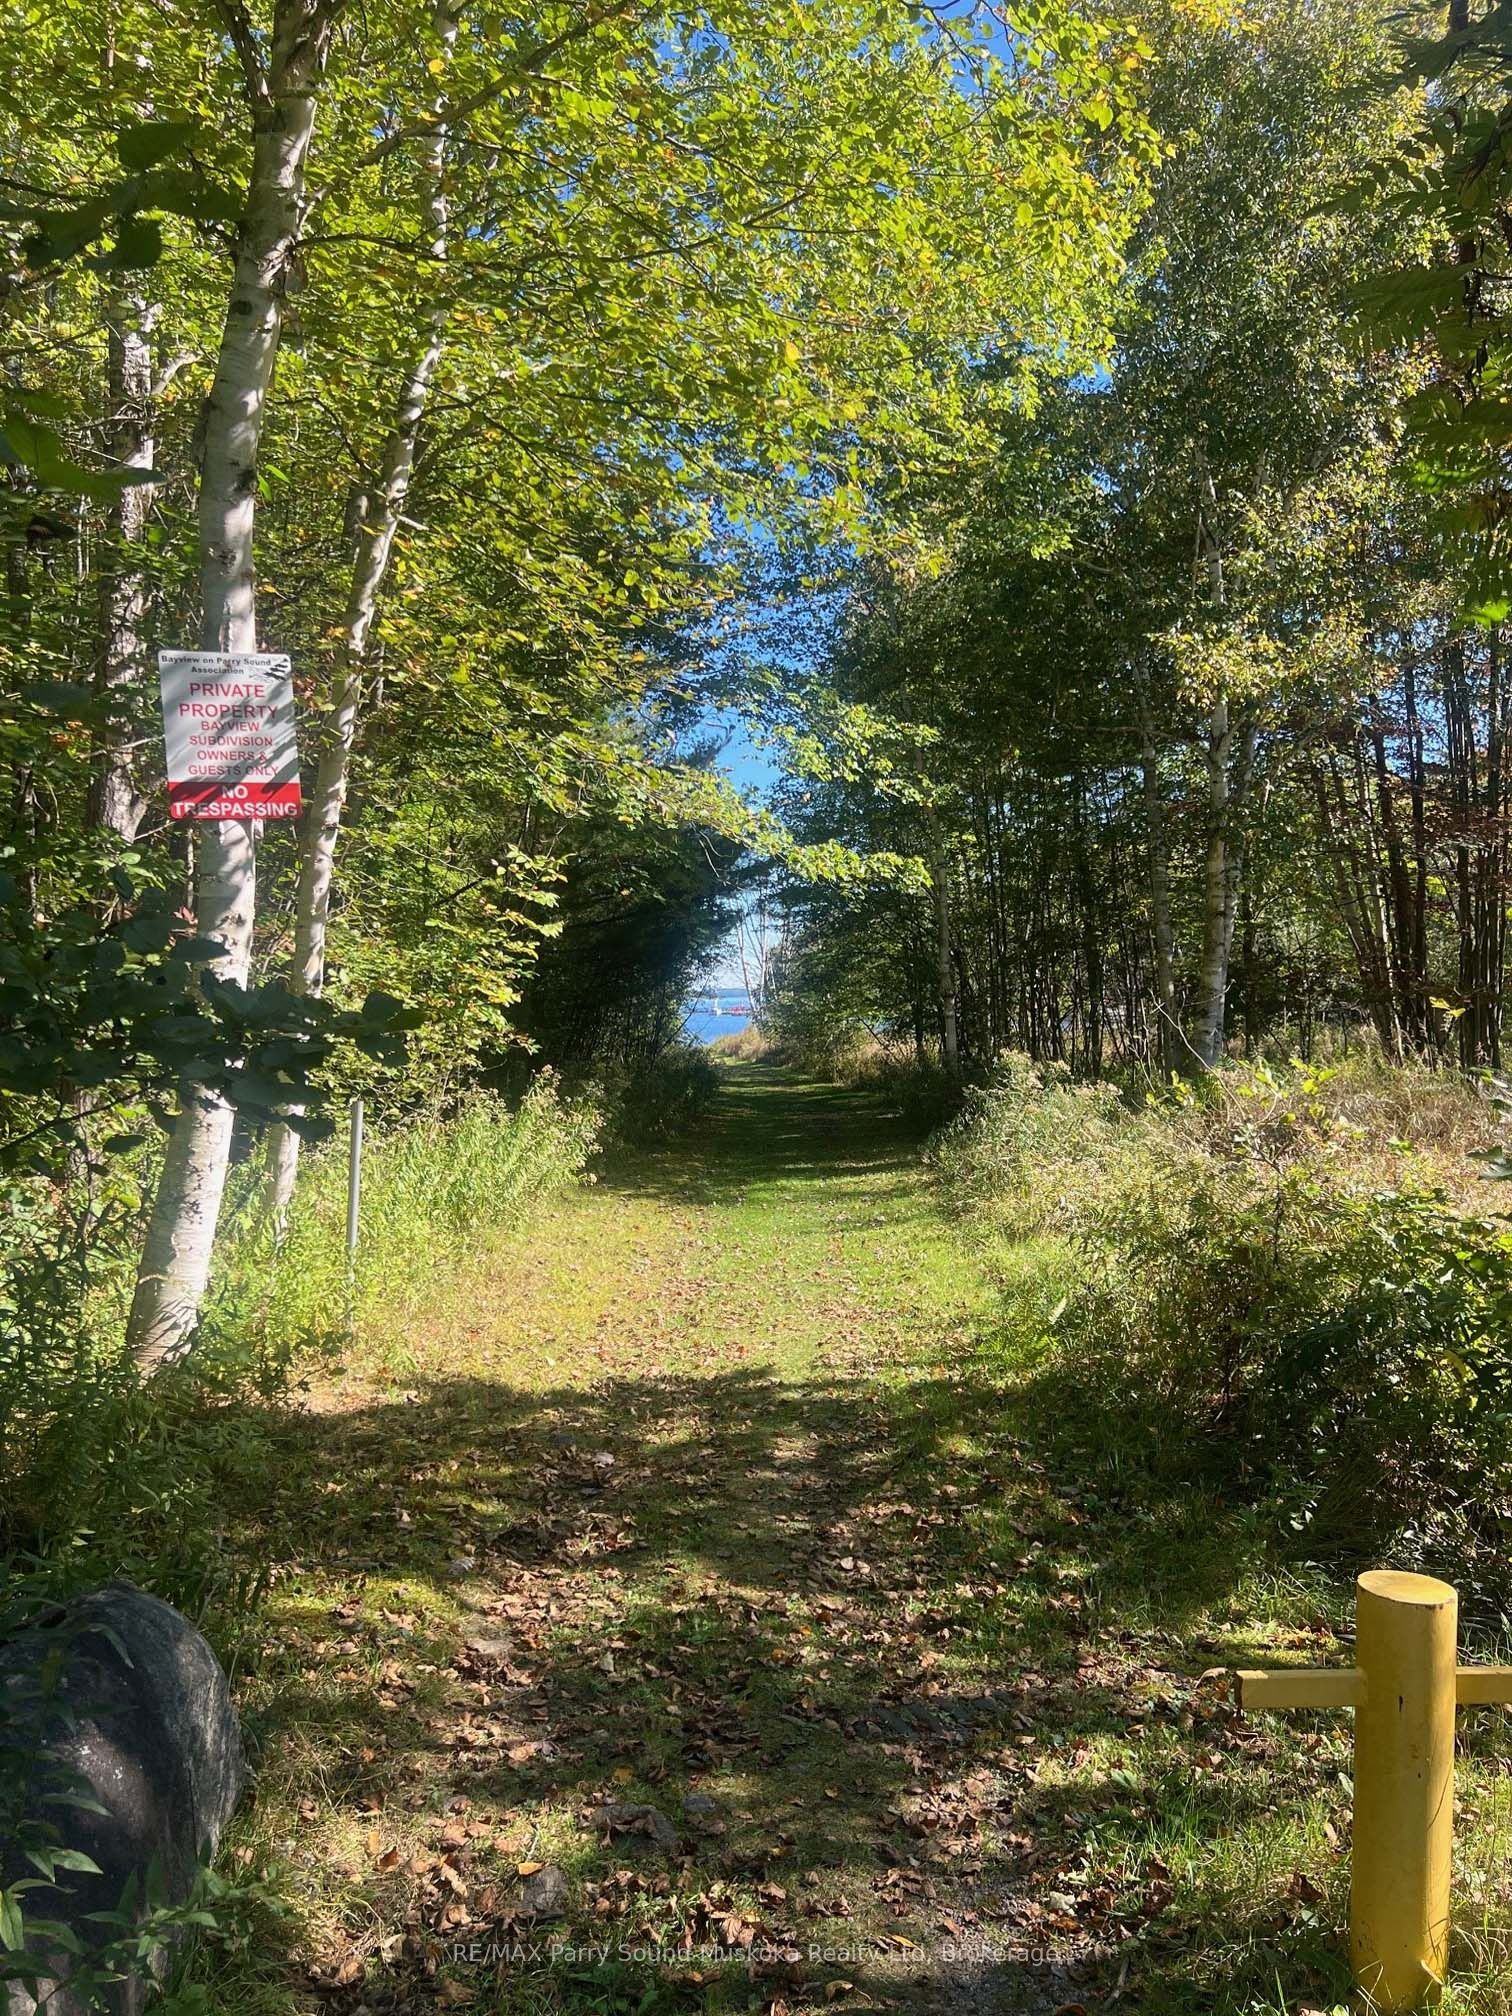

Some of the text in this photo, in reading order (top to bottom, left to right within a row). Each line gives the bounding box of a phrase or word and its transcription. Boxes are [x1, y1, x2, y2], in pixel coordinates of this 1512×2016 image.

[161, 655, 200, 664] Bayview
[216, 657, 241, 666] Parry
[191, 666, 244, 675] Association
[189, 682, 265, 698] PRIVATE
[179, 703, 279, 719] PROPERTY
[201, 721, 260, 732] BAYVIEW
[189, 735, 273, 747] SUBDIVISION
[196, 750, 255, 761] OWNERS
[188, 764, 279, 776] GUESTS ONLY
[221, 784, 248, 799] NO
[173, 801, 298, 817] TRESPASSING
